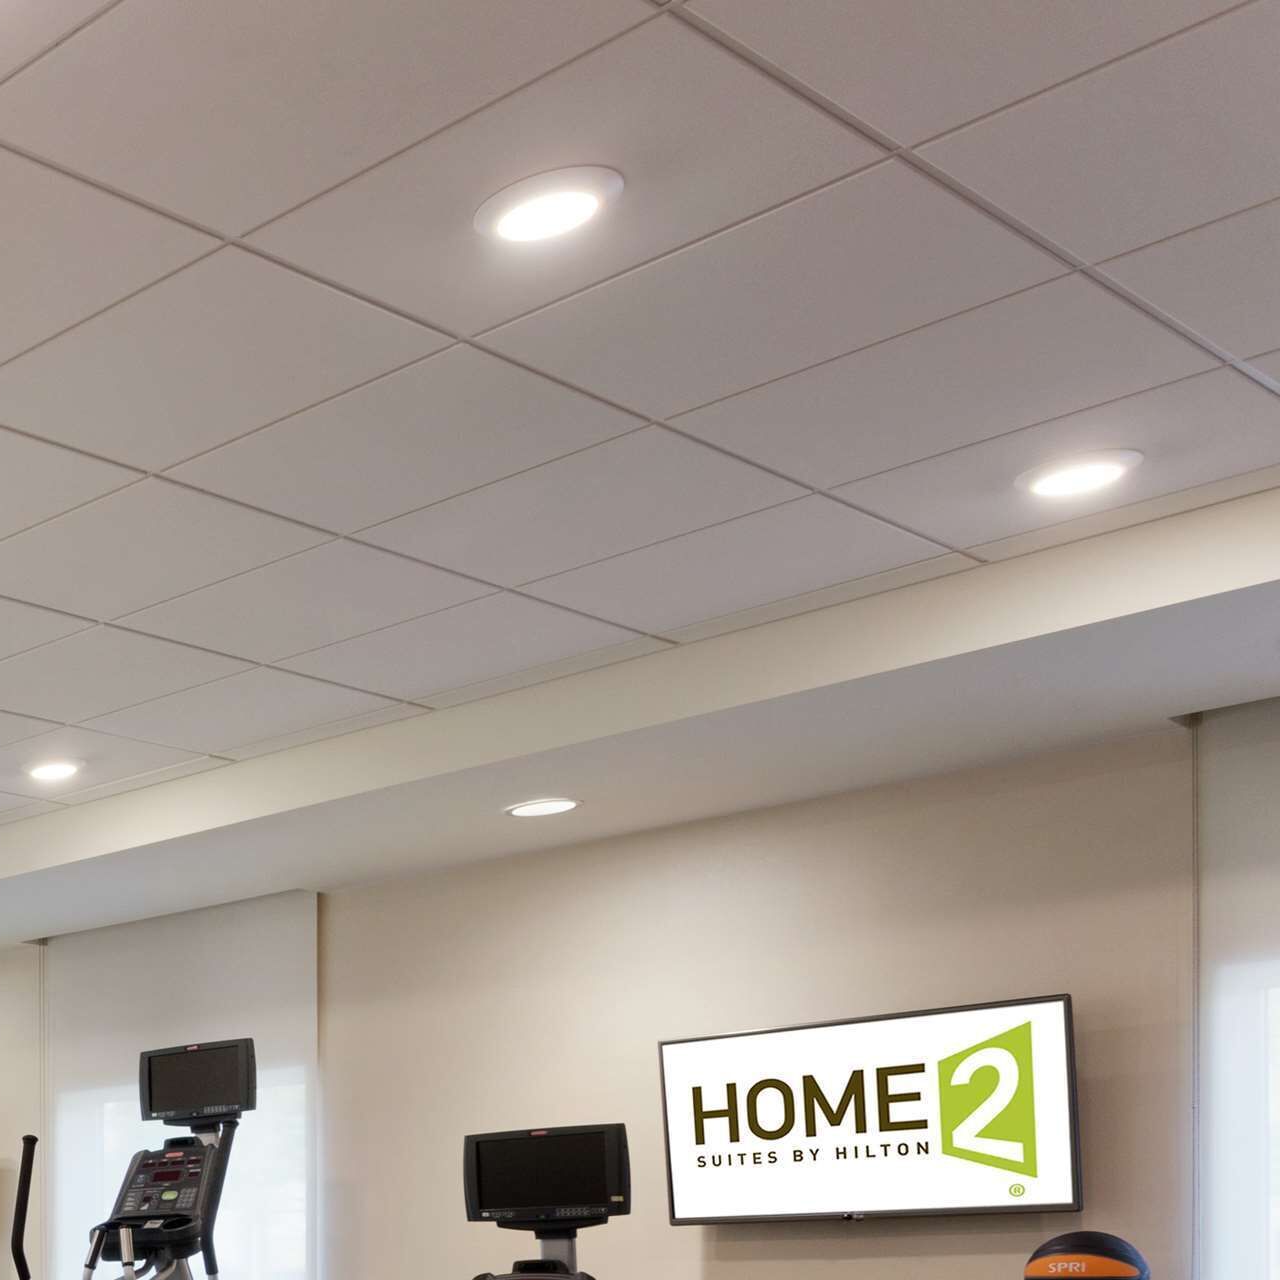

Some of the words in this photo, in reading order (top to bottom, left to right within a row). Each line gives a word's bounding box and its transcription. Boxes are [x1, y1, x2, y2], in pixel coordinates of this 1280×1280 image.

[697, 1151, 778, 1168] SUITES
[793, 1148, 820, 1162] BY
[836, 1141, 930, 1160] HILTON
[1048, 1262, 1085, 1273] SPRI
